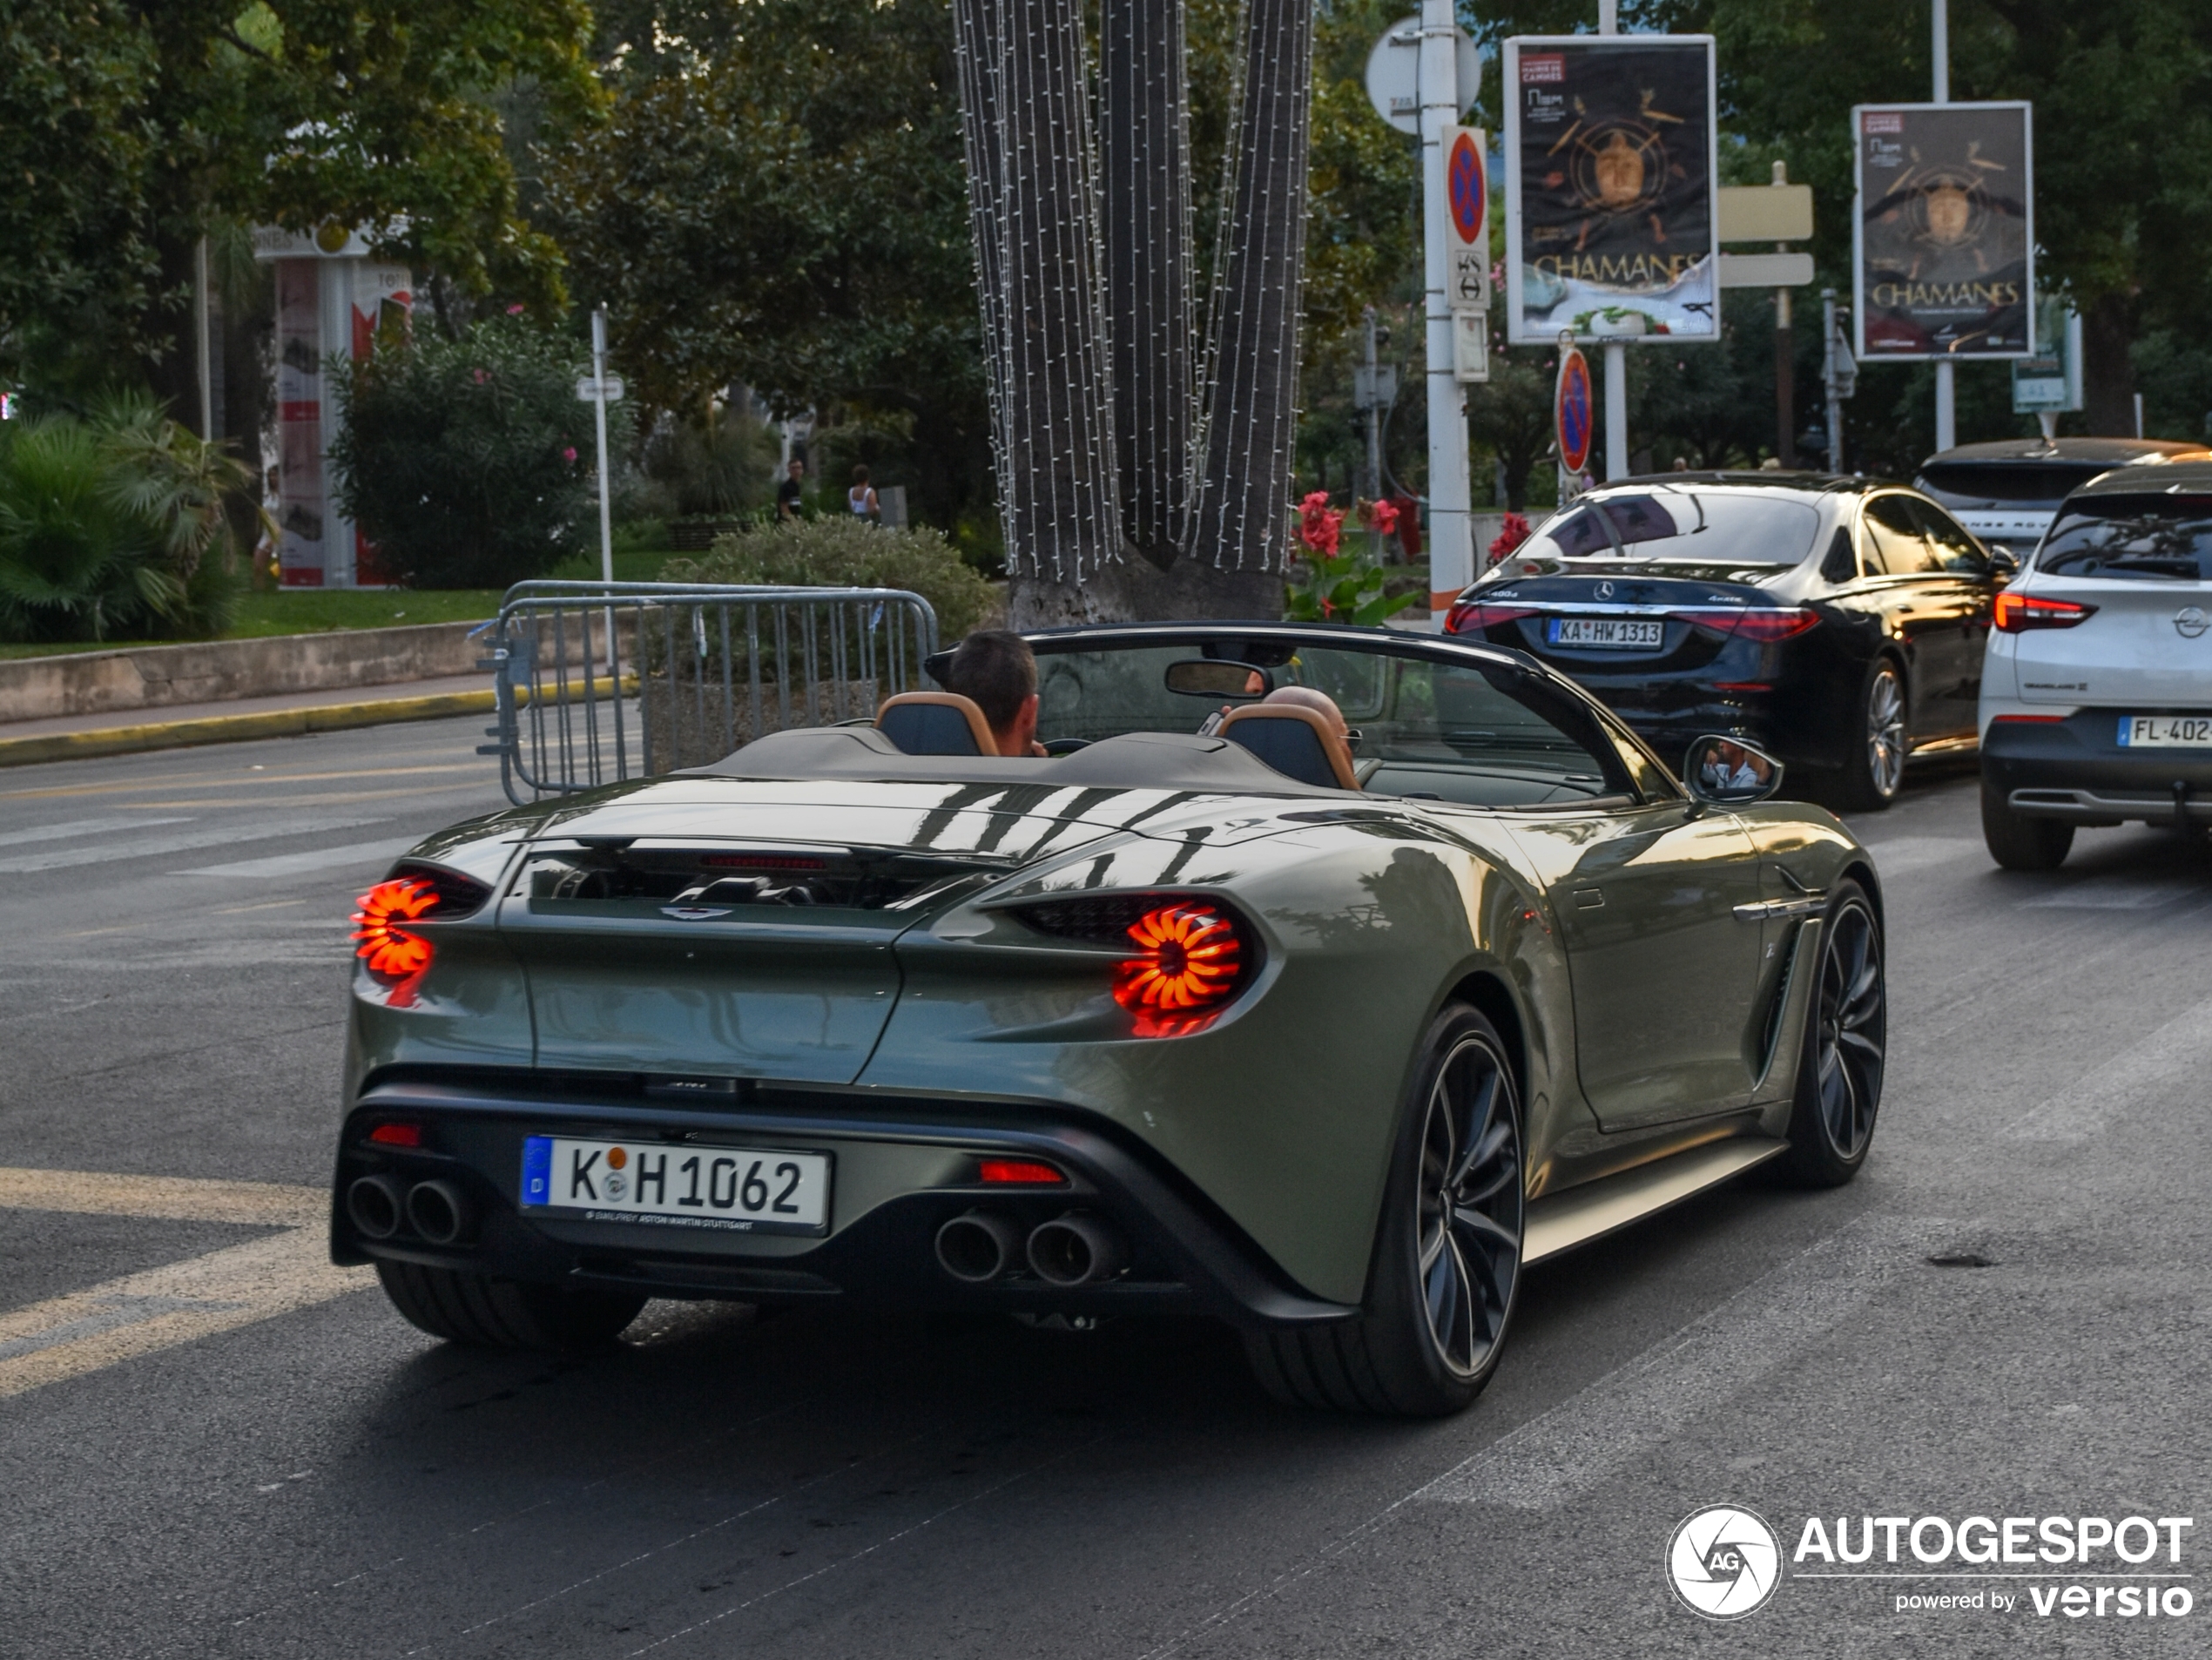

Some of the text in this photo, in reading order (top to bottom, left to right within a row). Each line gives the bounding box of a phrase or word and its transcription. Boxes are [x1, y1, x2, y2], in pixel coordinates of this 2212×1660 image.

[1534, 253, 1701, 284] CHAMANES
[1871, 280, 2019, 308] CHAMANES
[1561, 622, 1659, 643] KA HW 1313
[570, 1148, 602, 1201] K
